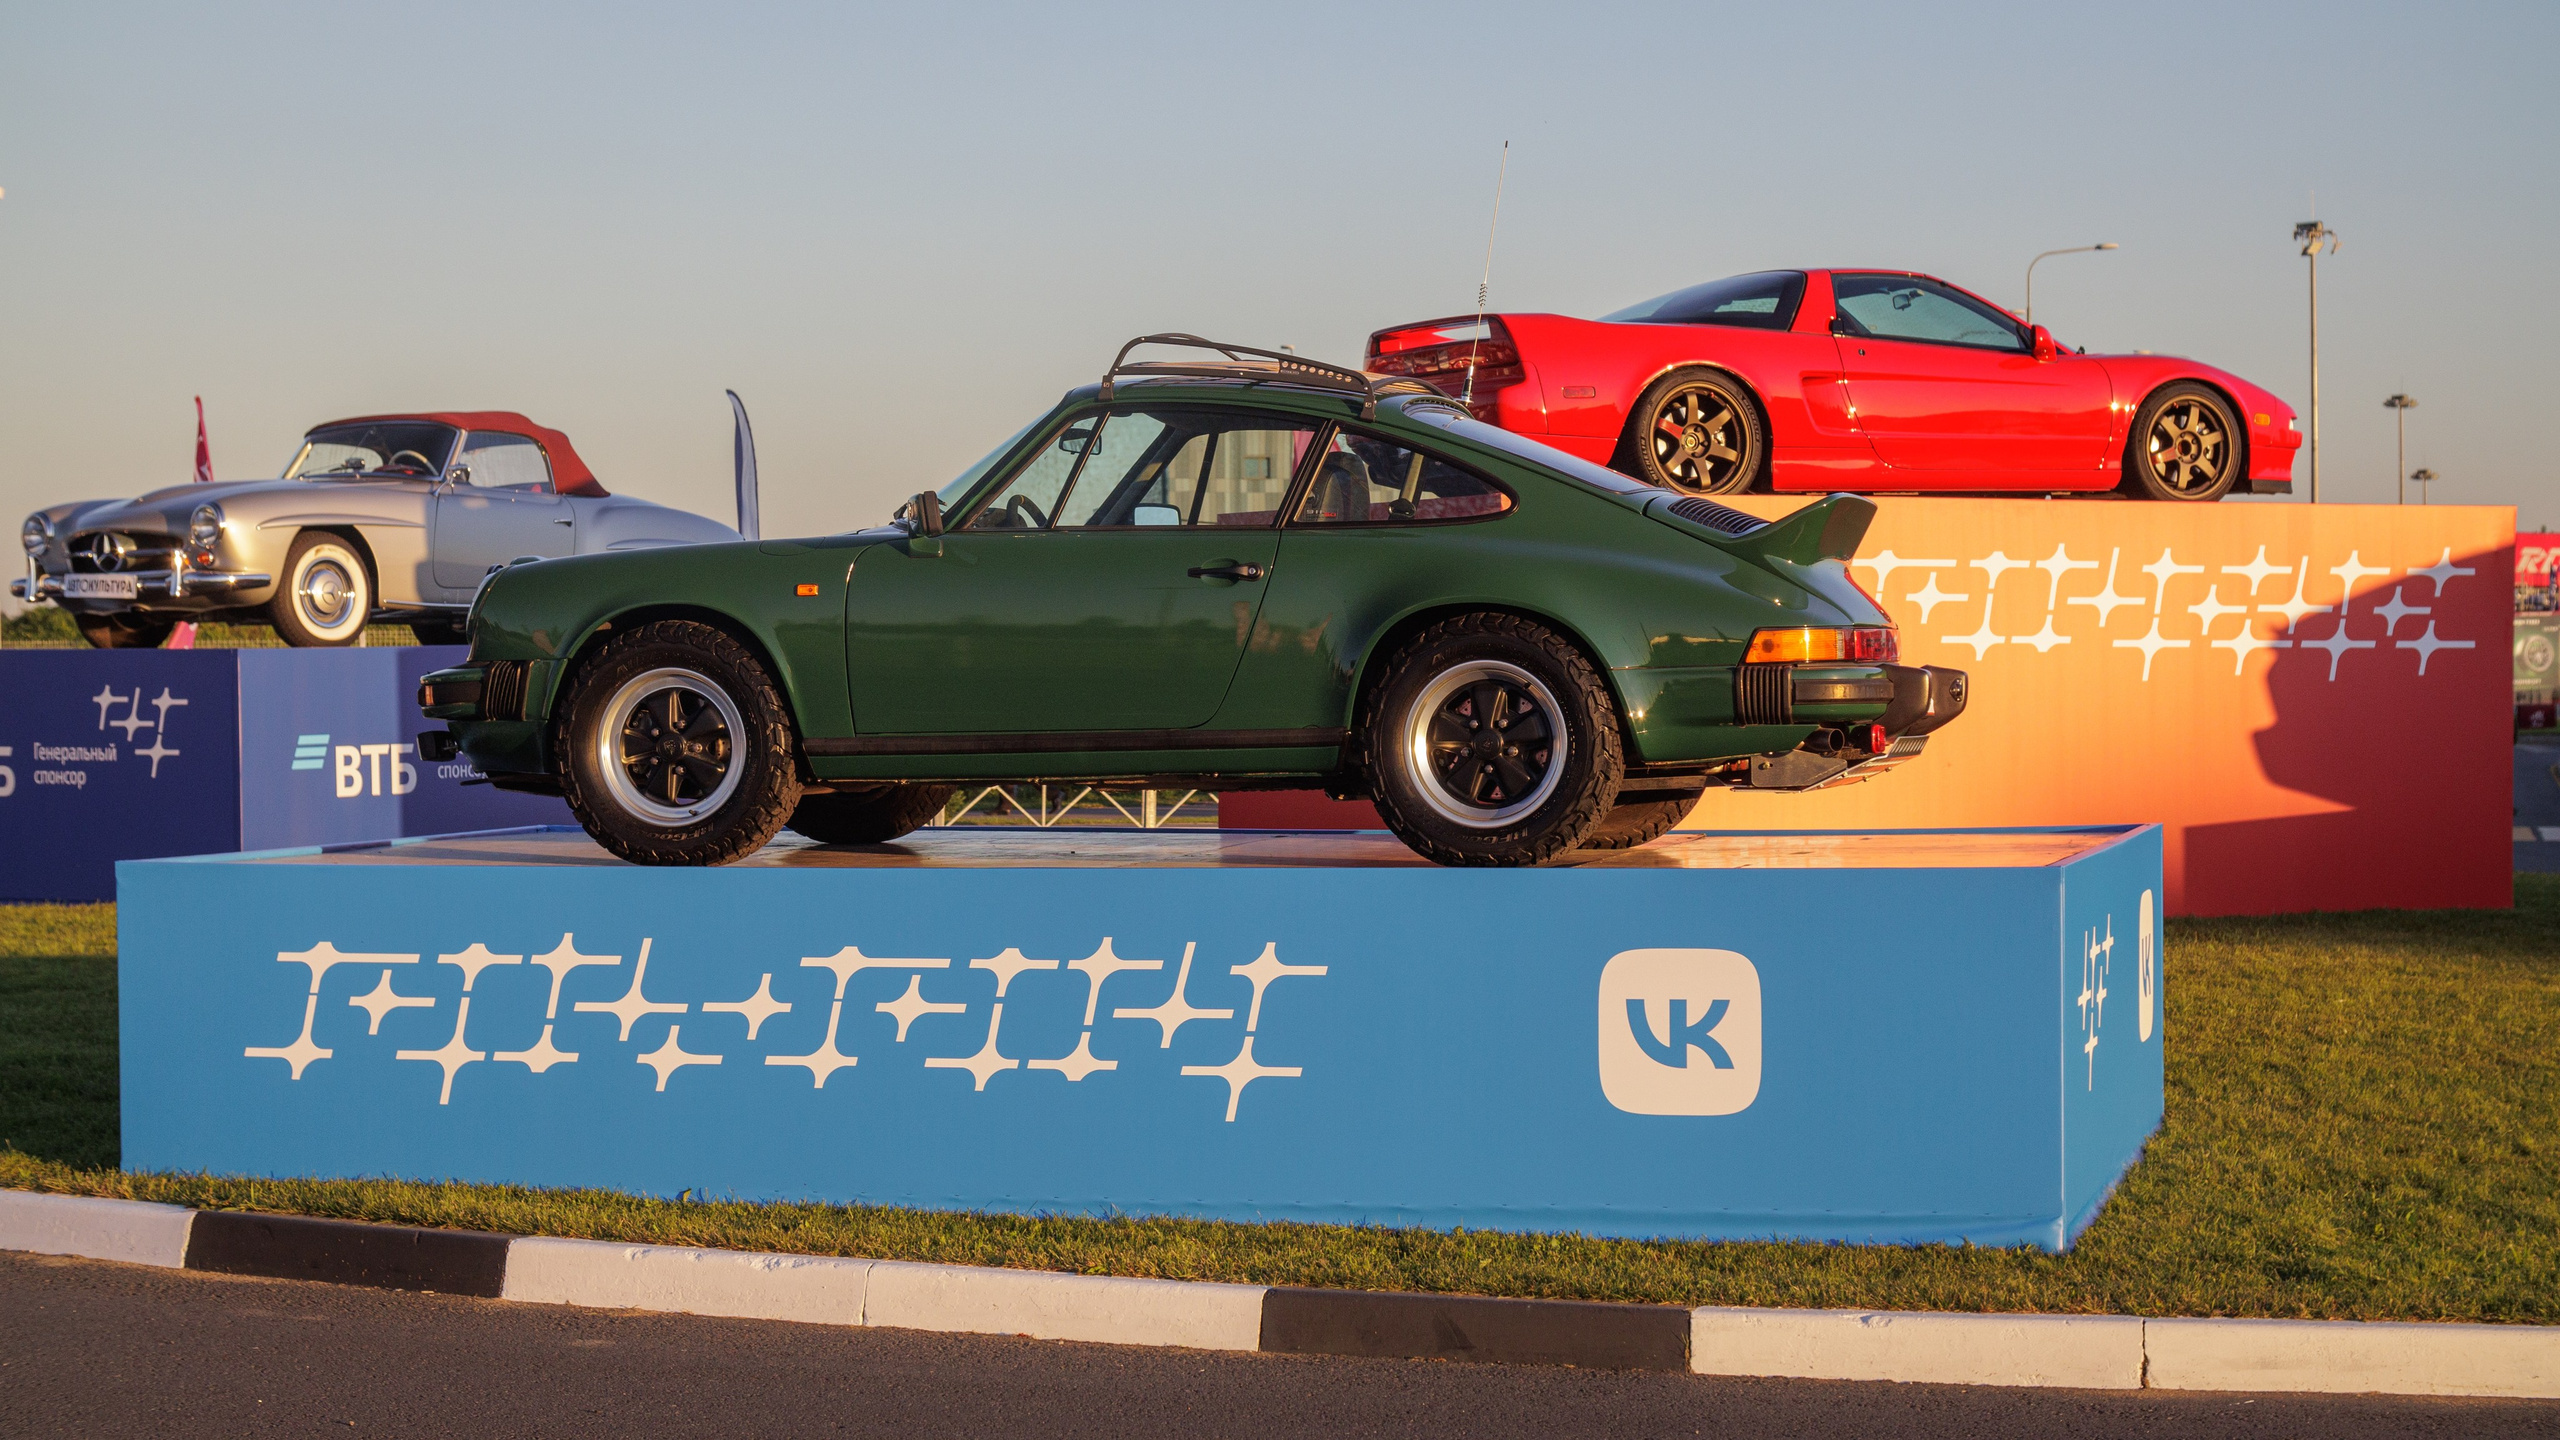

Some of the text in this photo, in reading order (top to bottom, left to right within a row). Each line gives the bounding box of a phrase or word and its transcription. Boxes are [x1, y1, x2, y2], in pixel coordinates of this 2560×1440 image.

[1640, 438, 1659, 481] MICHELIN
[67, 579, 132, 593] АВТОКУЛЬТУРА
[33, 742, 117, 765] Генеральный
[33, 769, 87, 790] спонсор
[334, 743, 418, 798] ВТБ
[1626, 998, 1735, 1069] VK
